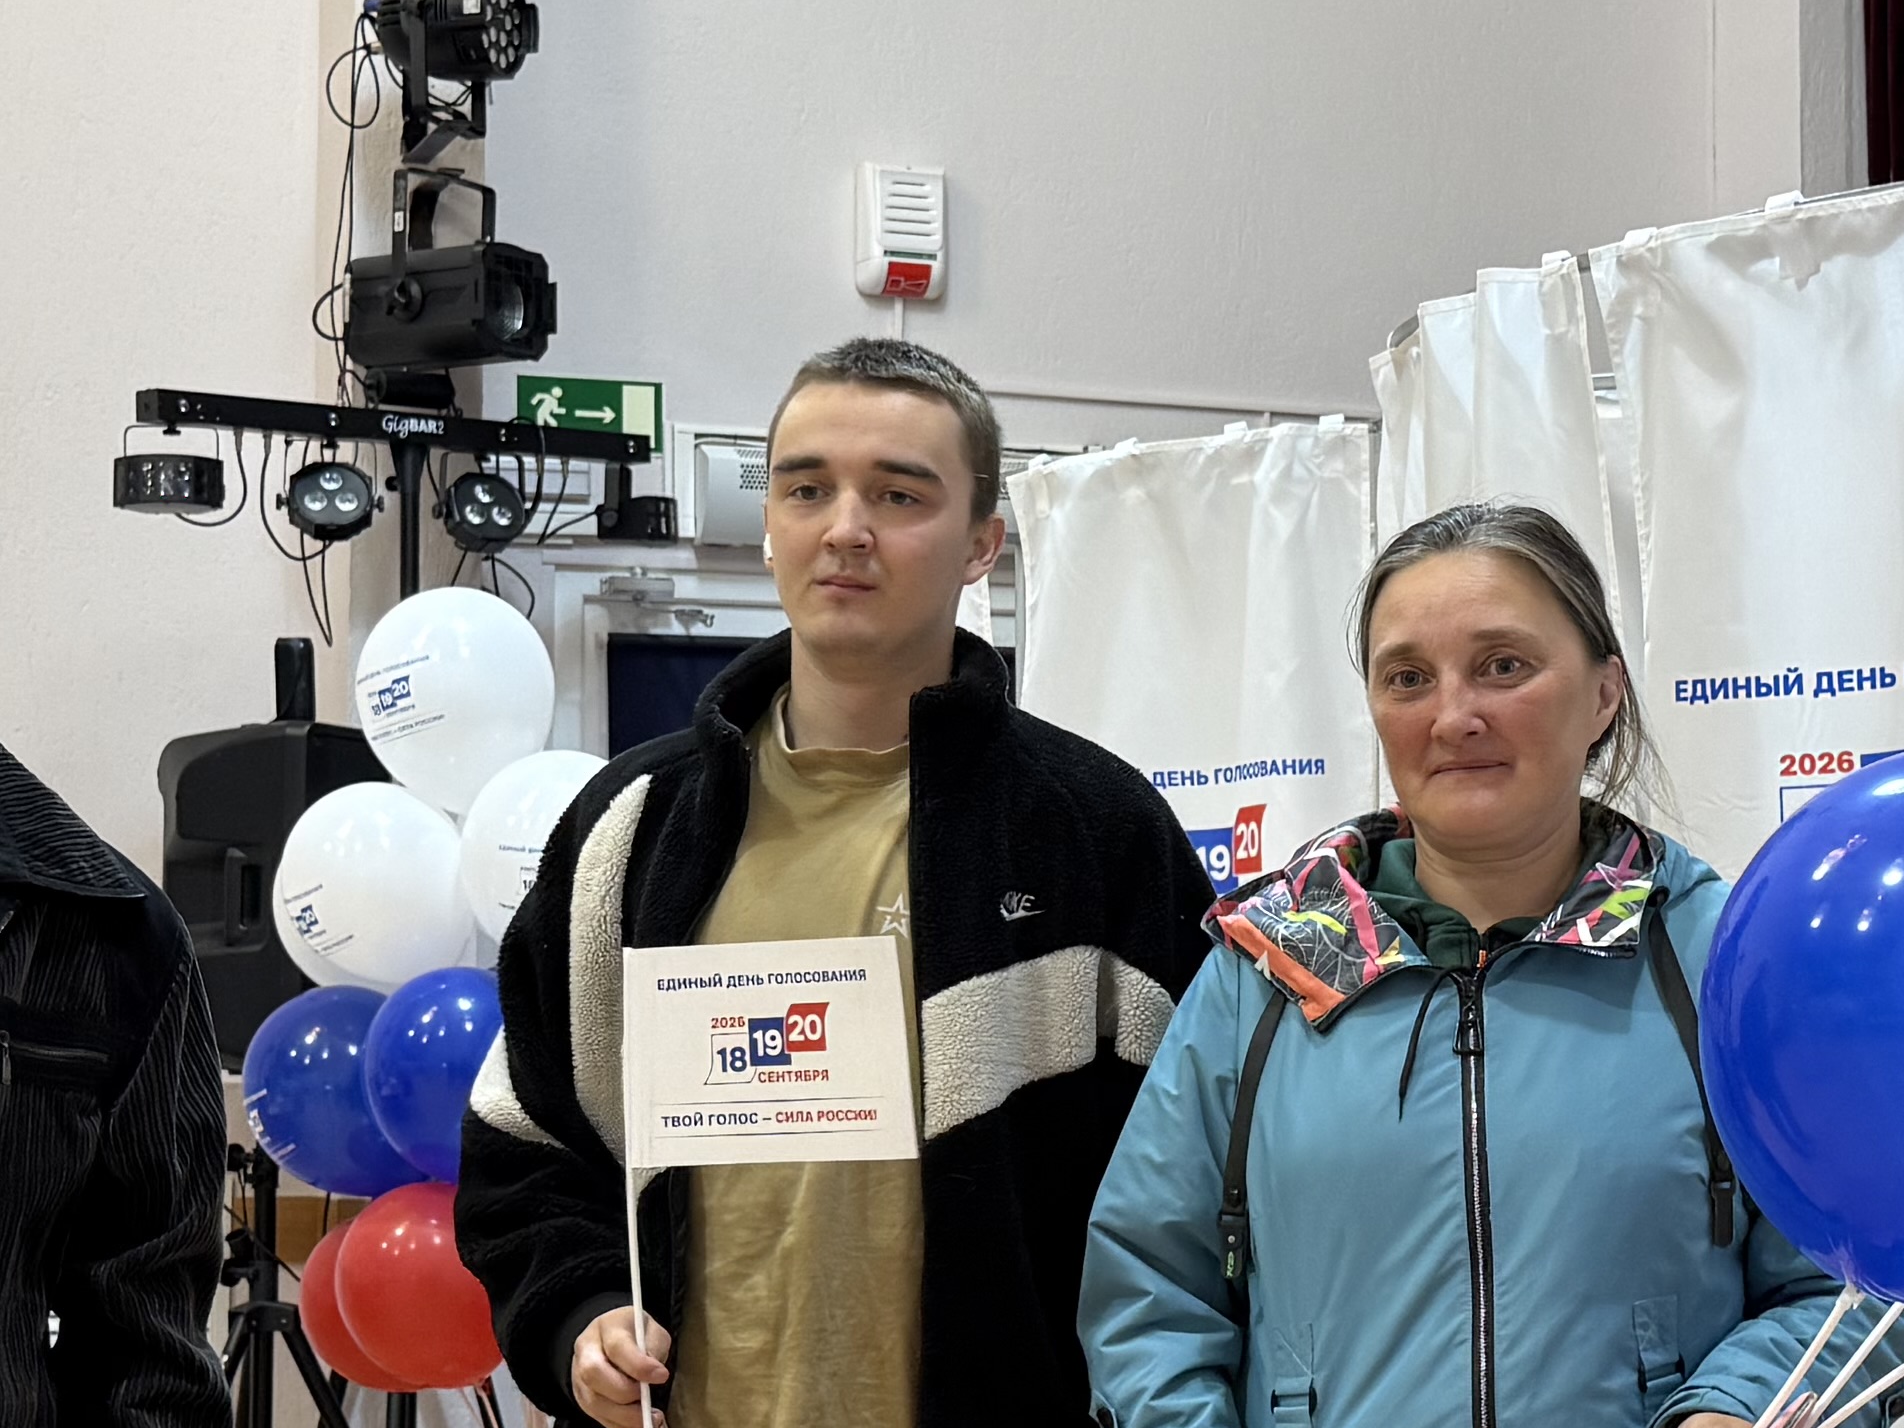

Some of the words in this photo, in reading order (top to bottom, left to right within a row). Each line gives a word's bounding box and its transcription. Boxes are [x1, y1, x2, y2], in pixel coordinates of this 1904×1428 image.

[392, 681, 408, 697] 20
[1675, 667, 1804, 705] ЕДИНЫЙ
[1813, 666, 1896, 698] ДЕНЬ
[1780, 751, 1854, 776] 2026
[1153, 770, 1209, 789] ДЕНЬ
[1236, 821, 1259, 860] 20
[657, 973, 723, 992] ЕДИНЫЙ
[726, 975, 764, 989] ДЕНЬ
[767, 969, 867, 986] ГОЛОСОВАНИЯ
[711, 1016, 745, 1029] 2026
[717, 1046, 747, 1073] 18
[752, 1029, 784, 1056] 19
[787, 1014, 823, 1042] 20
[758, 1069, 829, 1084] СЕНТЯБРЯ
[661, 1111, 704, 1128] ТВОЙ
[708, 1112, 758, 1127] ГОЛОС
[775, 1110, 813, 1123] СИЛА
